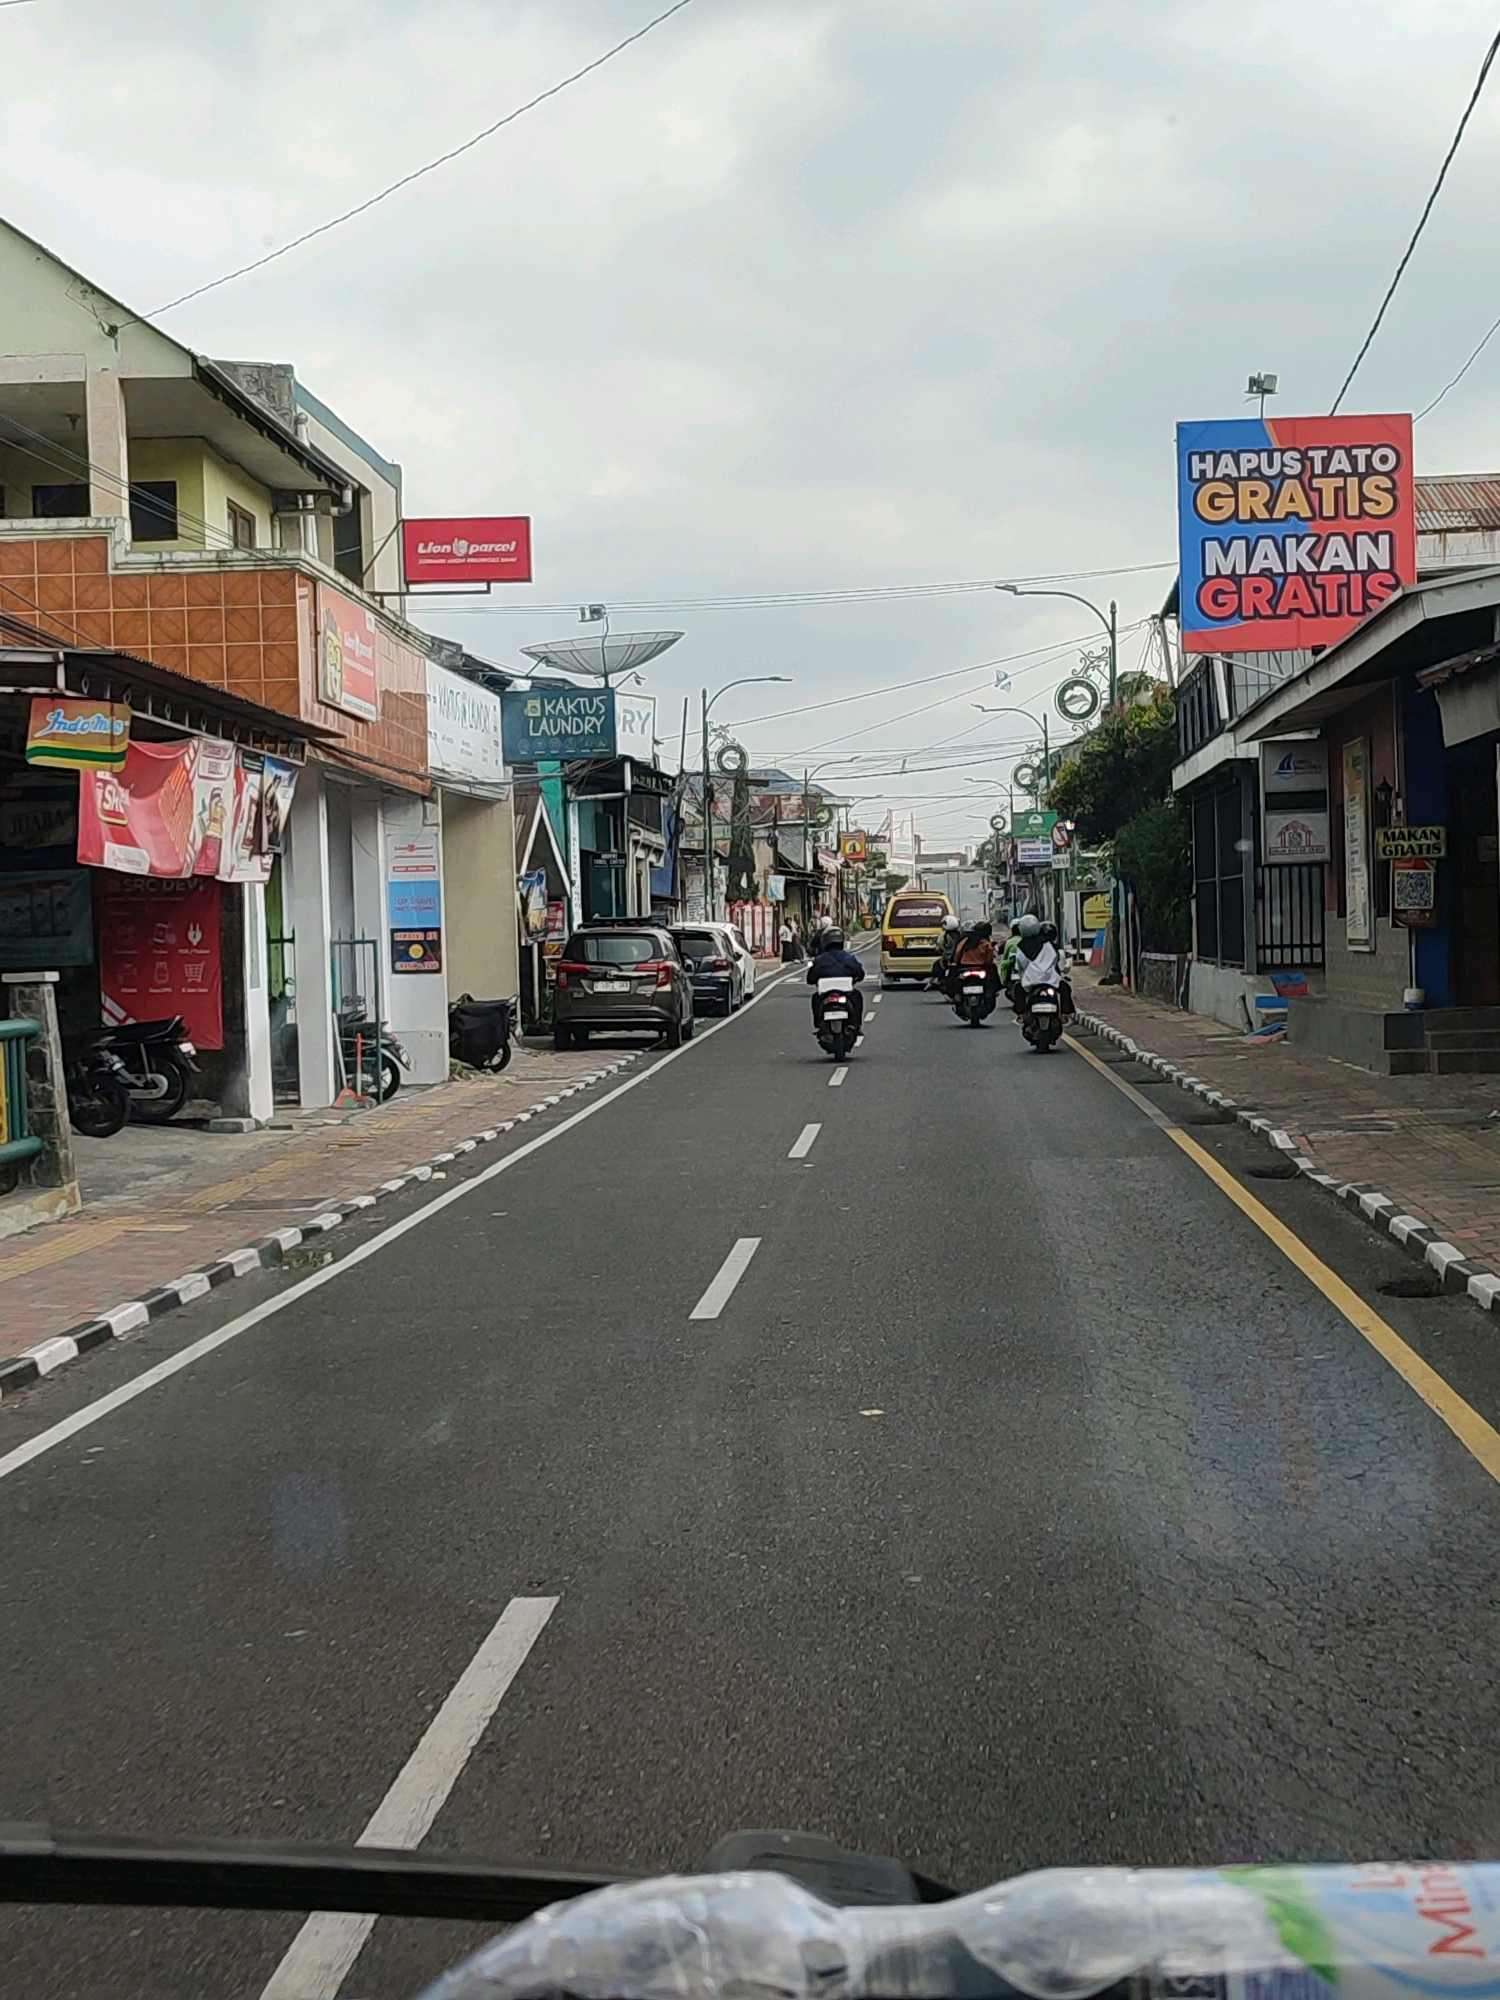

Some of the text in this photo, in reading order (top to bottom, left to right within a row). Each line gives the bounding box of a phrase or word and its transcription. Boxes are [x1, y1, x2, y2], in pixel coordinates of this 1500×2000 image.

[1190, 447, 1397, 479] HAPUS TATO
[1196, 475, 1395, 522] GRATIS
[468, 541, 517, 555] parcel
[1203, 533, 1391, 576] MAKAN
[1198, 571, 1396, 618] GRATIS
[543, 695, 608, 716] KAKTUS
[528, 715, 606, 737] LAUNDRY
[1382, 828, 1441, 844] MAKAN
[1381, 843, 1442, 858] GRATIS
